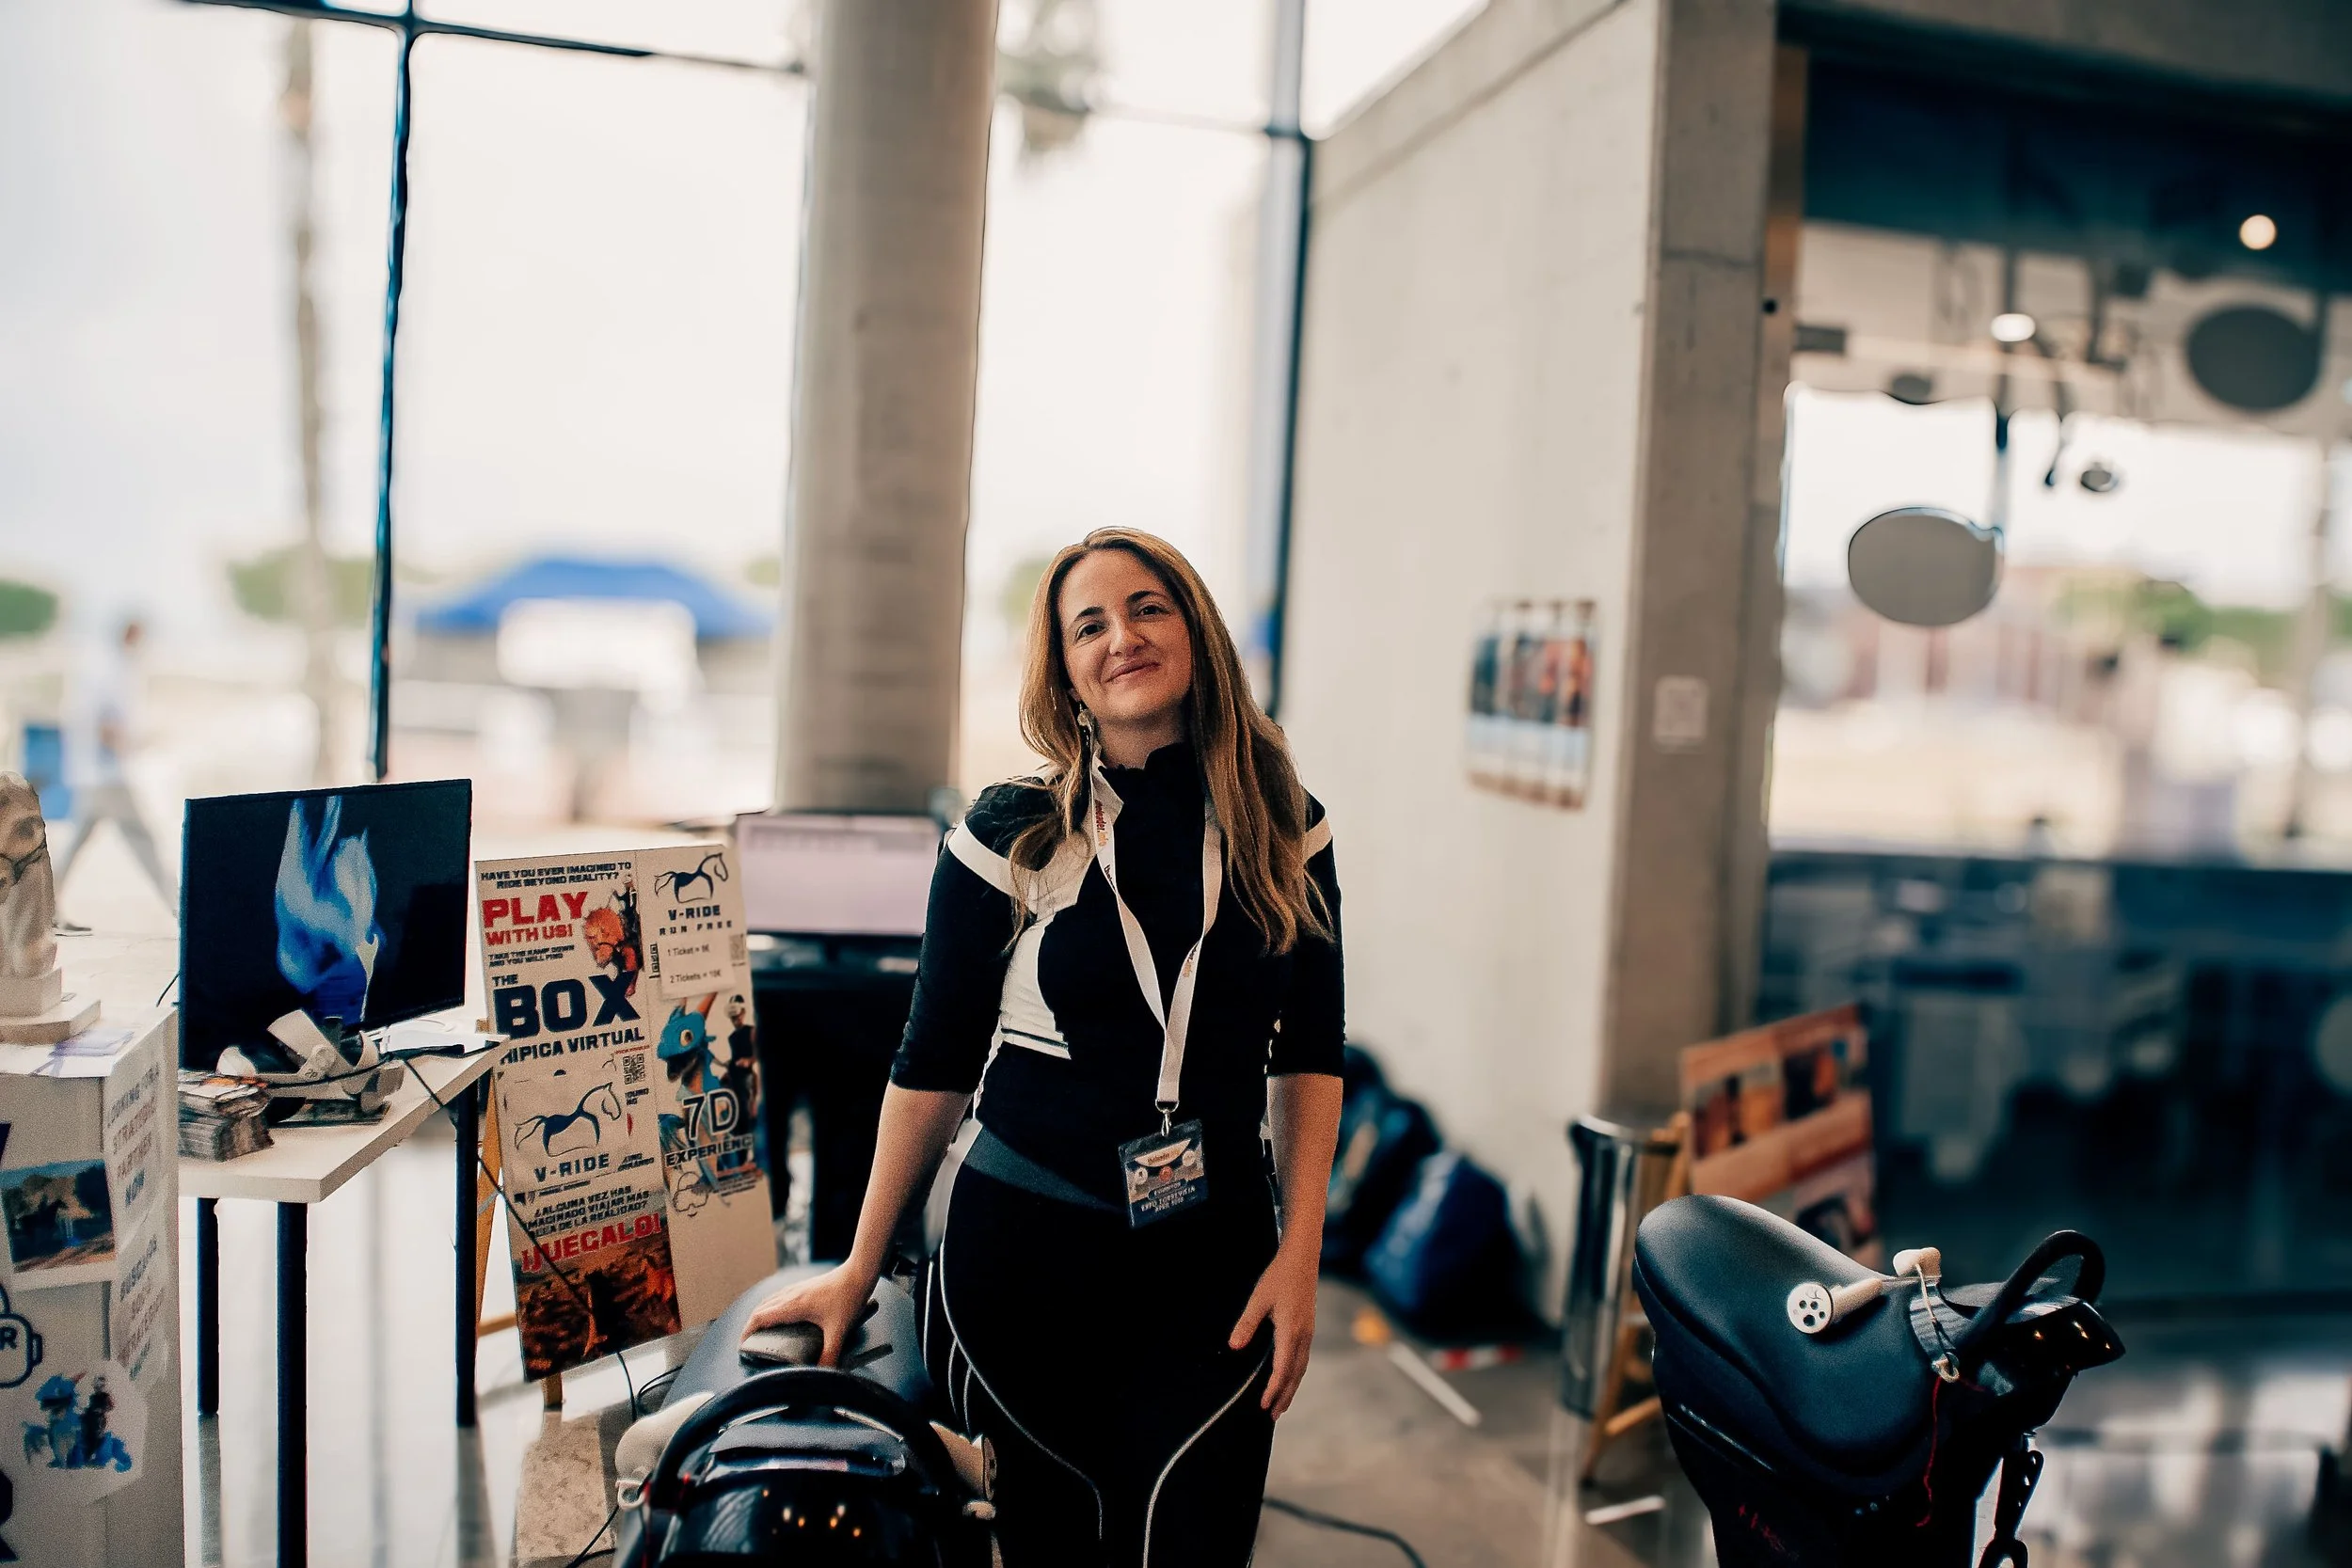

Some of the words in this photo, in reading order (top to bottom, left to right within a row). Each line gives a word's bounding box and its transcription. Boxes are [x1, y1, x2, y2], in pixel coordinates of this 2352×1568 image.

[481, 871, 510, 880] HAVE
[513, 868, 534, 878] YOU
[537, 867, 564, 876] EVER
[567, 863, 615, 873] IMAGINED
[617, 862, 631, 870] TO
[497, 880, 521, 889] RIDE
[524, 877, 566, 886] BEYOND
[569, 873, 619, 882] REALITY?
[483, 892, 588, 928] PLAY
[668, 905, 721, 921] V-RIDE
[485, 927, 539, 946] WITH
[542, 924, 573, 940] US!
[660, 926, 688, 936] RUN
[697, 921, 732, 930] FREE
[674, 946, 693, 957] Ticket
[492, 974, 518, 987] THE
[670, 975, 675, 984] 2
[676, 972, 701, 982] Tickets
[493, 974, 641, 1039] BOX
[567, 1027, 644, 1054] VIRTUAL
[682, 1088, 739, 1141] 7D
[666, 1134, 754, 1166] EXPERIENC
[534, 1153, 610, 1182] V-RIDE
[587, 1191, 609, 1203] VEZ
[611, 1185, 631, 1197] HAS
[526, 1207, 585, 1229] MAGINADO
[587, 1196, 624, 1215] VIAJAR
[627, 1188, 649, 1203] MÁS
[559, 1222, 573, 1230] DE
[575, 1215, 588, 1227] LA
[590, 1200, 647, 1223] REALIDAD?
